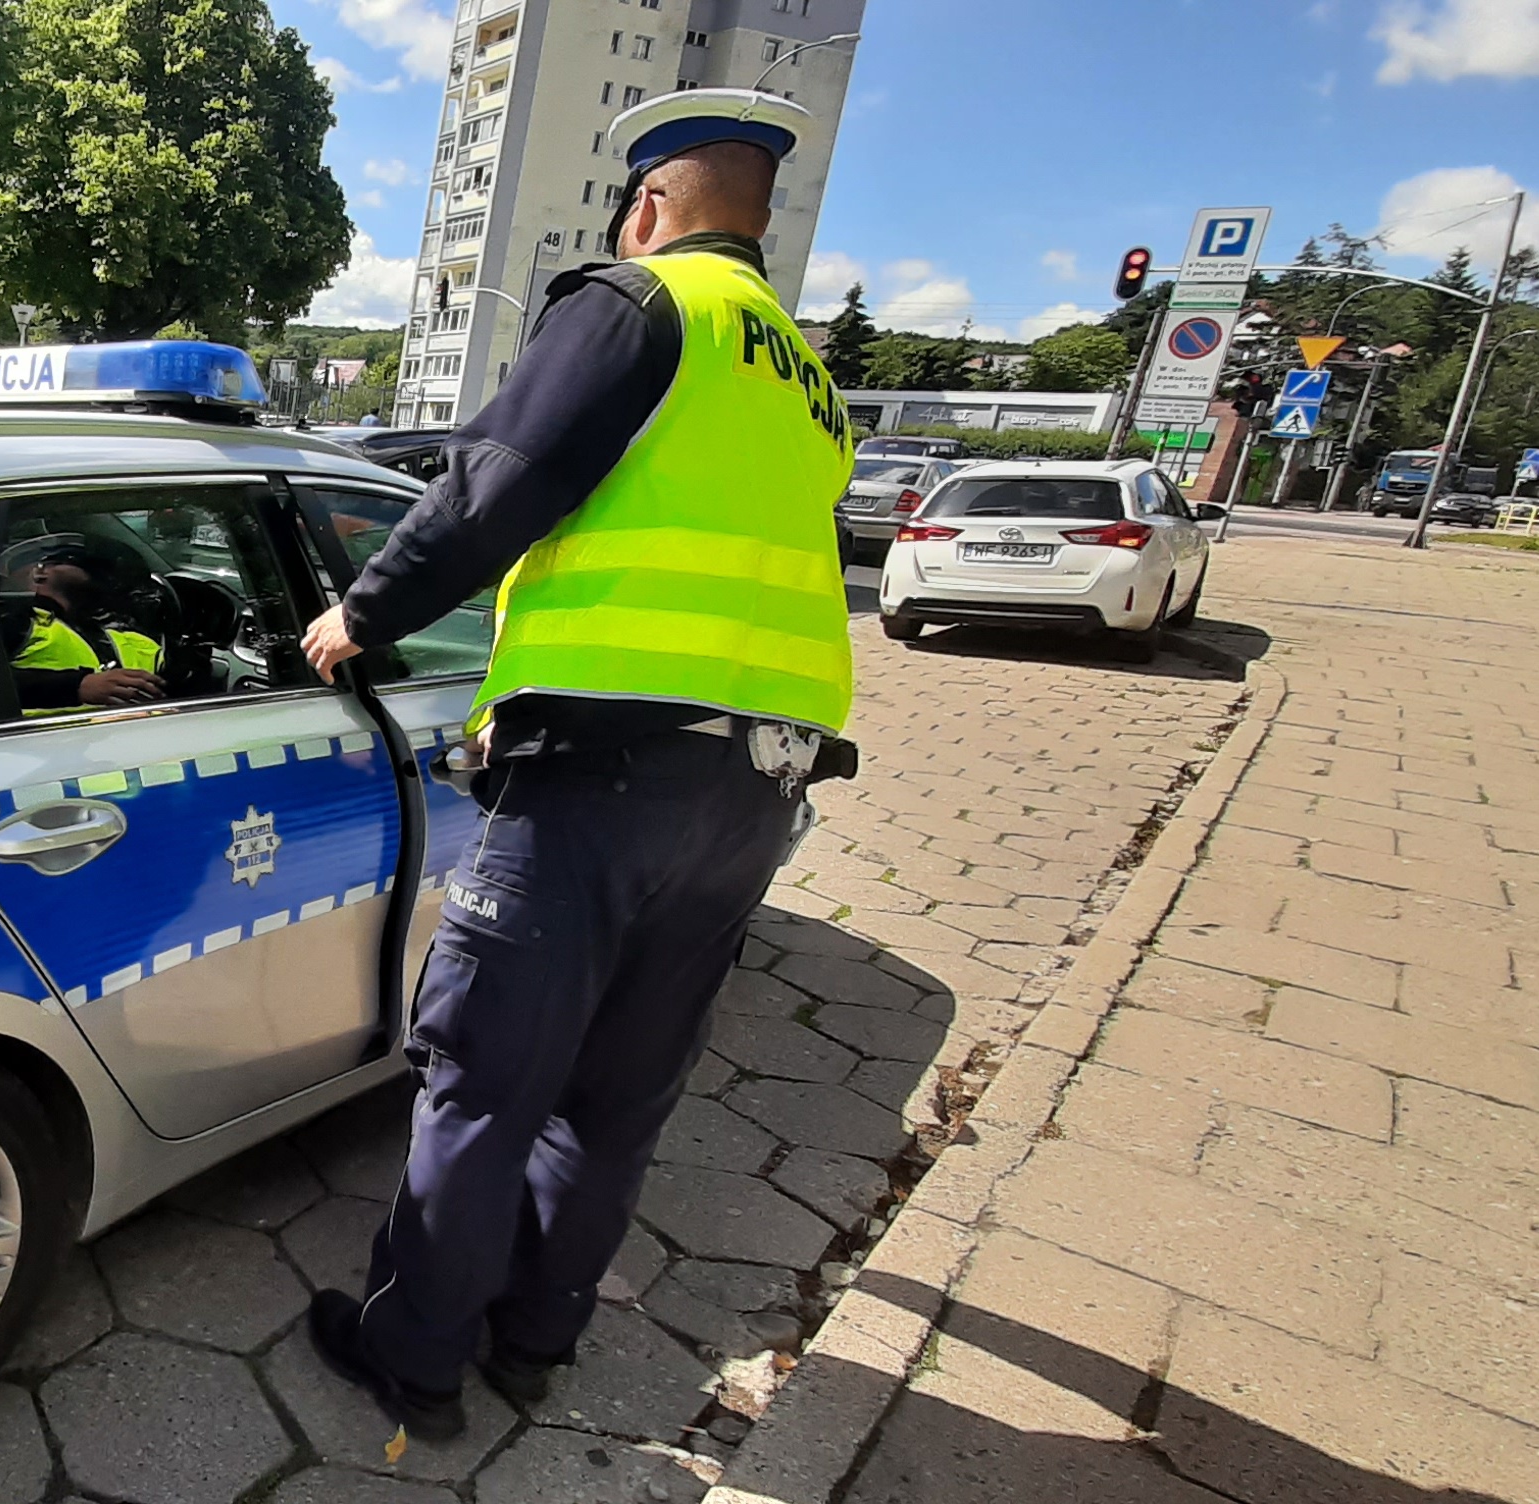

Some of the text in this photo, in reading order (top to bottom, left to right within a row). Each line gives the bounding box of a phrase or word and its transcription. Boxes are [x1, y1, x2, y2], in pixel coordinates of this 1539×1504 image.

[543, 231, 561, 247] 48
[236, 823, 271, 841] POLICJA
[446, 881, 498, 921] POLICJA
